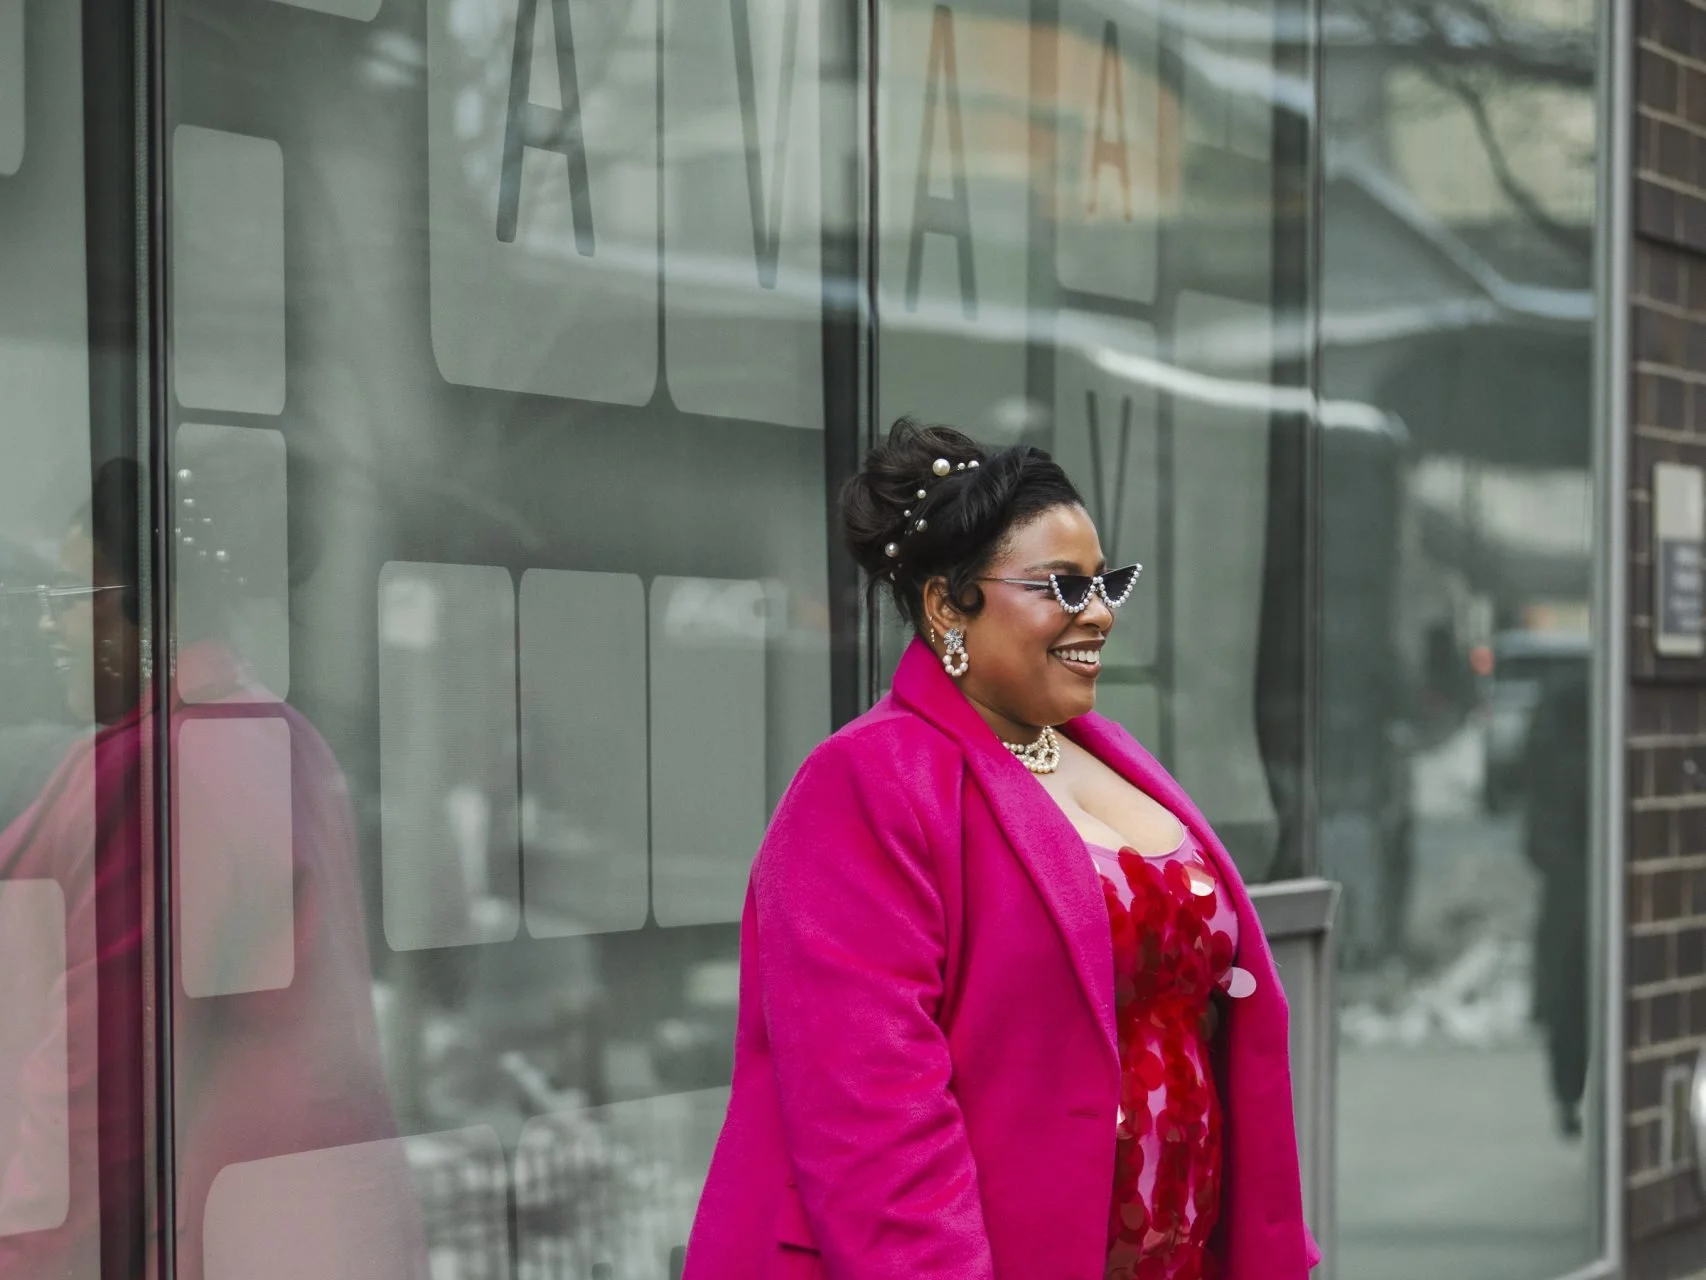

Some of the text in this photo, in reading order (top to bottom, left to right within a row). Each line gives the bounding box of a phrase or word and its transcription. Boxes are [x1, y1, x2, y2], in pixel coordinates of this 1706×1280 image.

[496, 0, 595, 257] A
[905, 4, 978, 320] A
[1087, 20, 1132, 222] A
